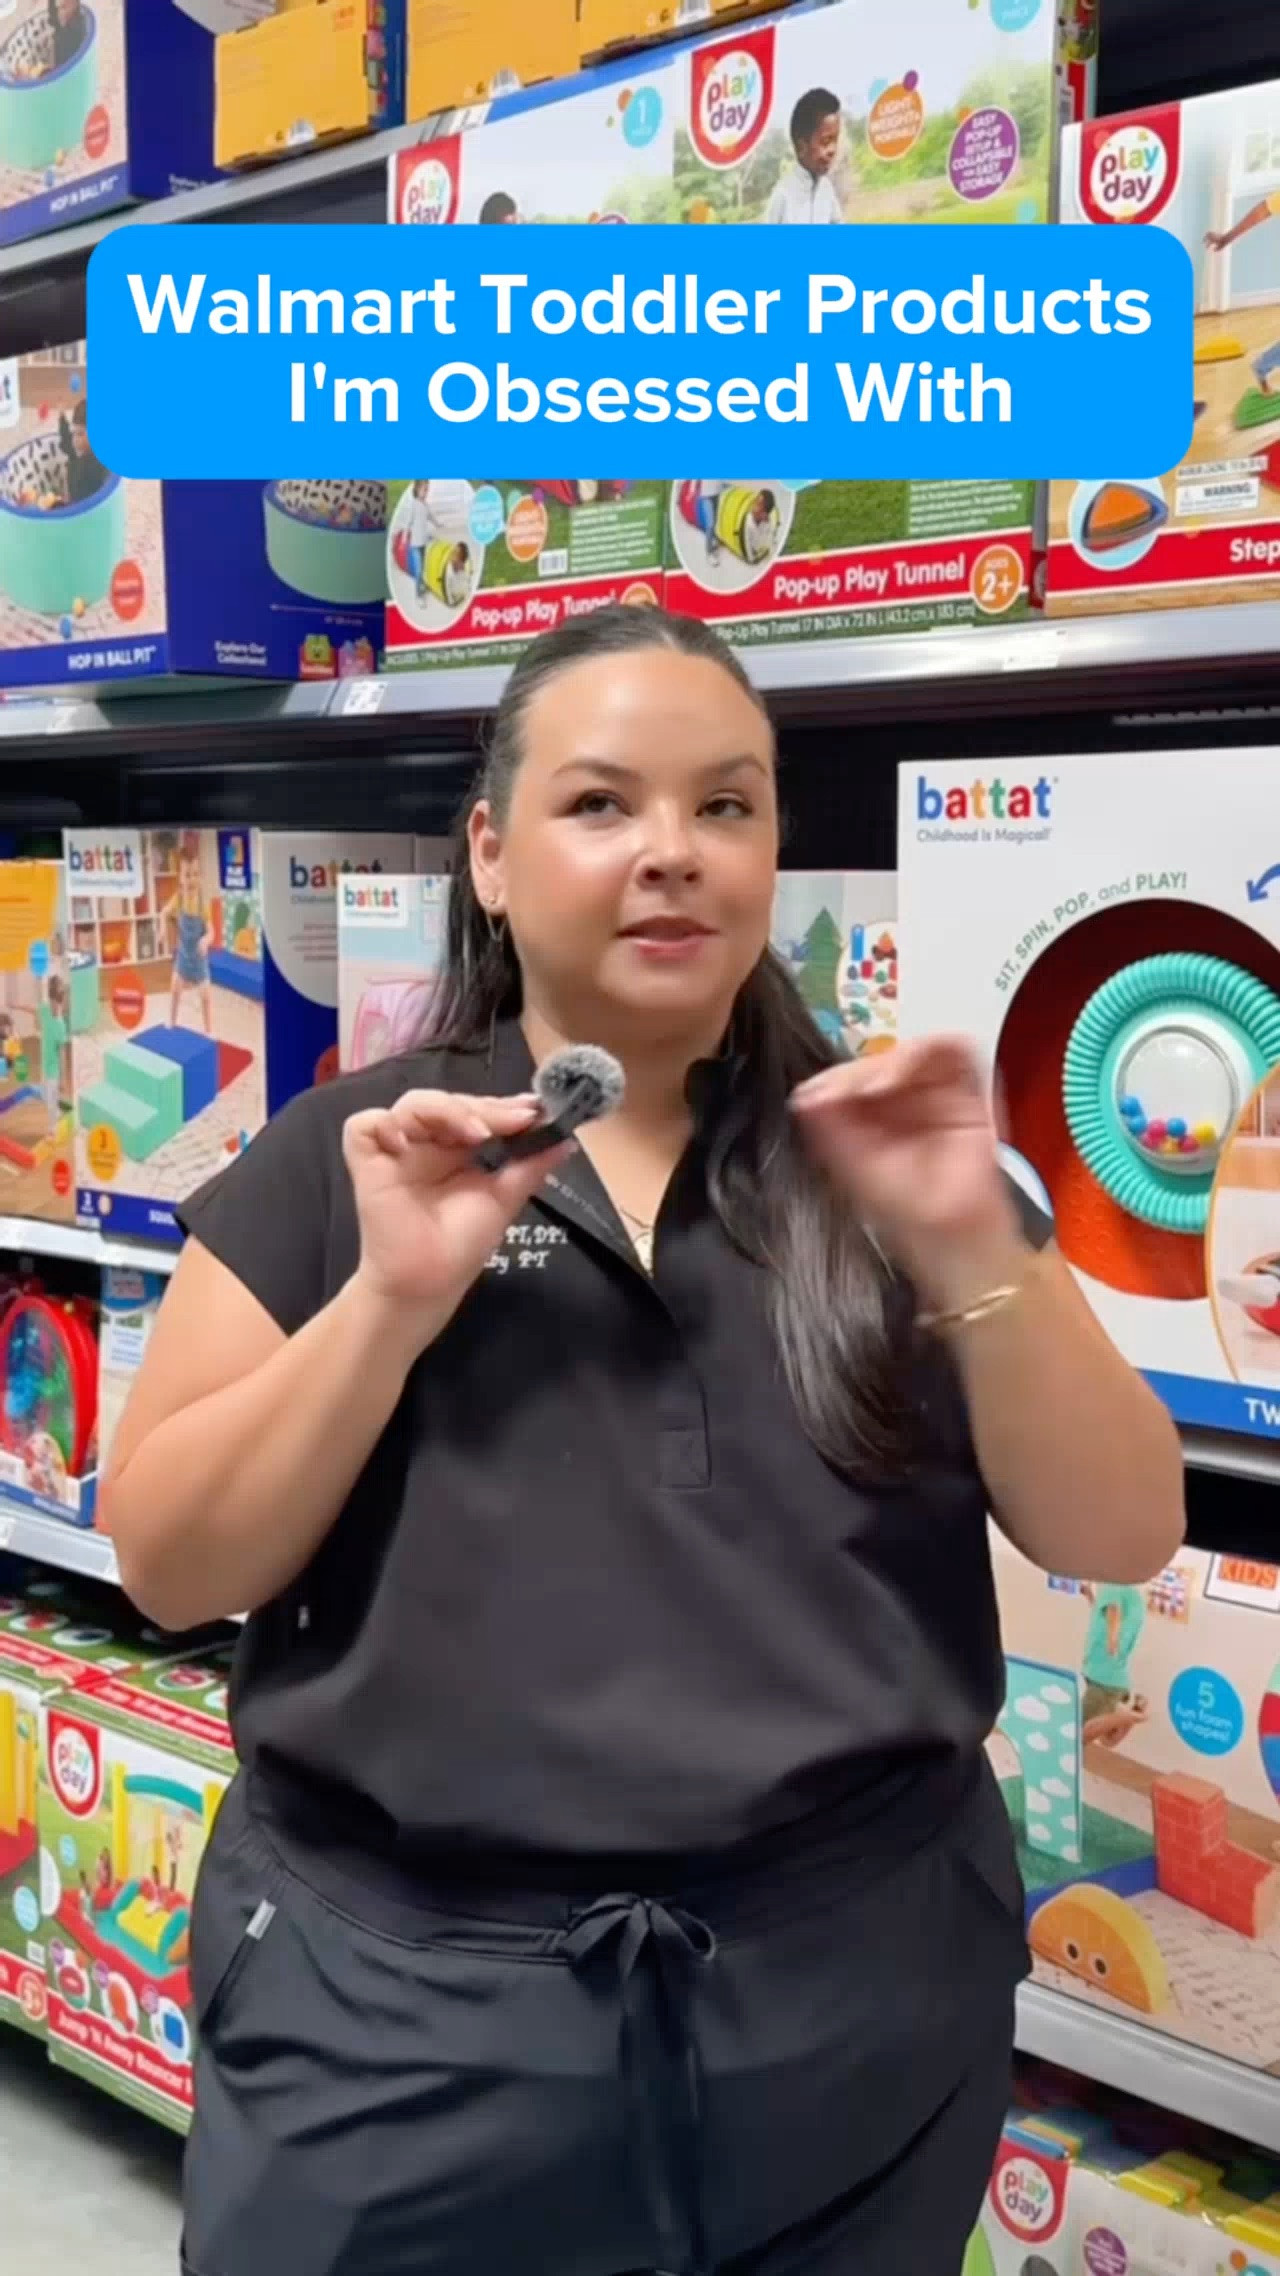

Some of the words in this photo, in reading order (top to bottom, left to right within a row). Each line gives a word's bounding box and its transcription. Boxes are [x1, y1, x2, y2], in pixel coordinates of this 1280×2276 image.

[706, 70, 757, 112] play
[709, 101, 751, 132] day
[1101, 144, 1159, 183] play
[407, 177, 448, 212] play
[1103, 174, 1153, 203] day
[1229, 537, 1280, 565] Step
[774, 574, 841, 602] Pop-up
[845, 565, 889, 595] Play
[894, 553, 967, 585] Tunnel
[981, 571, 1012, 601] 2+
[471, 604, 523, 632] Pop-up
[525, 598, 560, 626] Play
[917, 775, 1051, 821] battat
[916, 828, 979, 842] Childhood
[69, 841, 133, 872] battat
[343, 884, 399, 908] battat
[995, 959, 1022, 992] SIT,
[1015, 919, 1055, 961] SPIN,
[1053, 891, 1095, 923] POP,
[1097, 876, 1131, 901] and
[1135, 871, 1187, 892] PLAY!
[518, 1249, 550, 1269] PT
[1221, 1556, 1277, 1591] KIDS
[1198, 1680, 1216, 1709] 5
[1175, 1701, 1197, 1719] fun
[1198, 1708, 1233, 1731] foam
[57, 1742, 91, 1775] play
[60, 1765, 87, 1796] day
[1004, 2171, 1049, 2204] play
[1005, 2190, 1043, 2223] day
